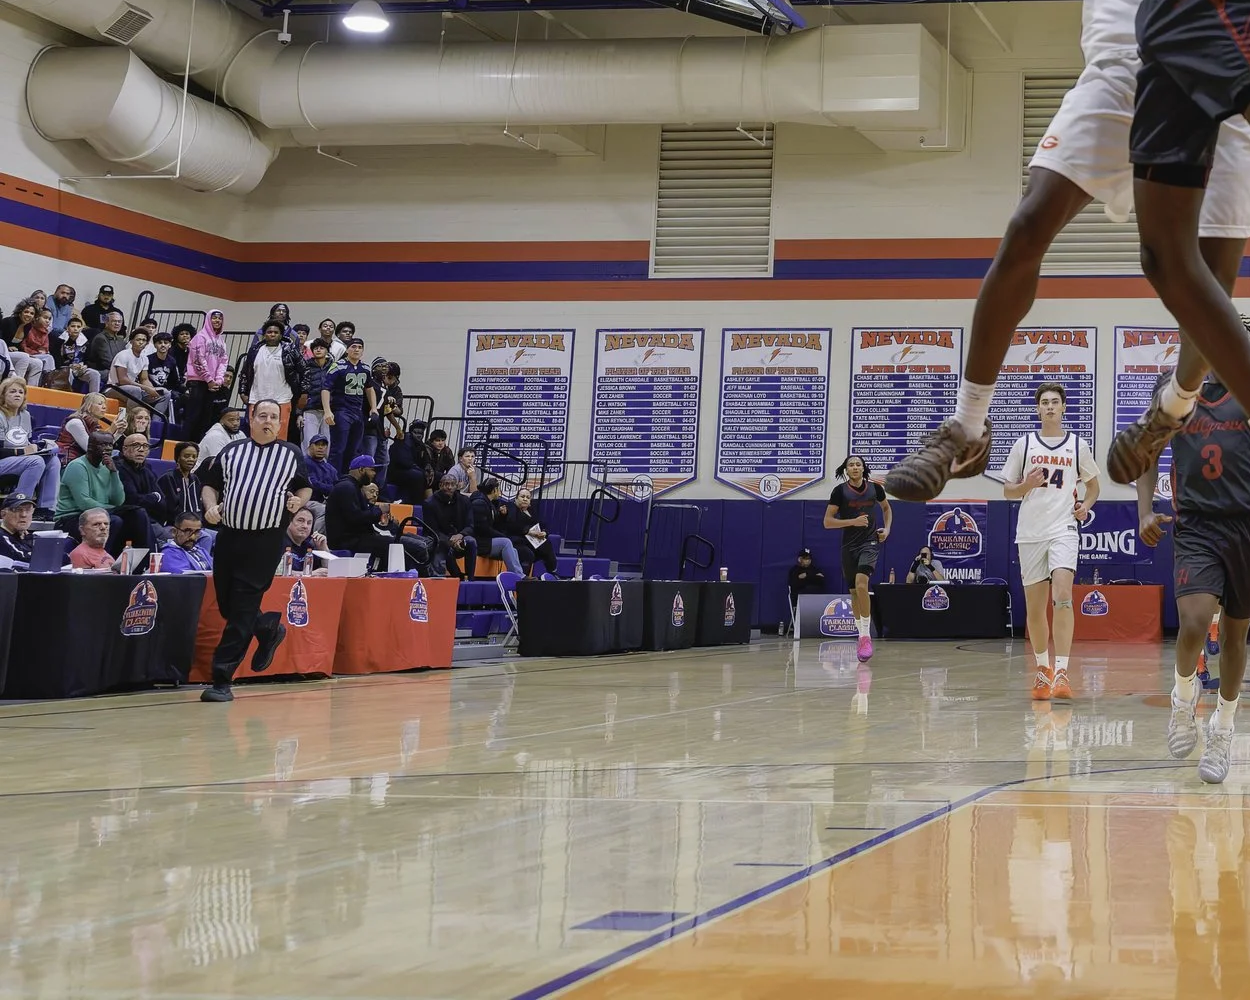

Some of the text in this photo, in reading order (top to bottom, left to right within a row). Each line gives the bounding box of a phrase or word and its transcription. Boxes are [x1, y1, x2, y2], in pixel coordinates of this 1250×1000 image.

[476, 334, 565, 352] NEVADA
[604, 333, 695, 352] NEVADA
[730, 333, 822, 352] NEVADA
[860, 330, 954, 350] NEVADA
[1011, 330, 1089, 349] EVADA
[1122, 330, 1181, 349] NEVA
[1030, 455, 1072, 468] GORMAN
[1201, 444, 1224, 480] 3
[931, 535, 979, 544] TARKANIAN
[938, 542, 971, 550] CLASSIC
[1080, 528, 1136, 556] DING
[944, 568, 982, 580] KANIAN
